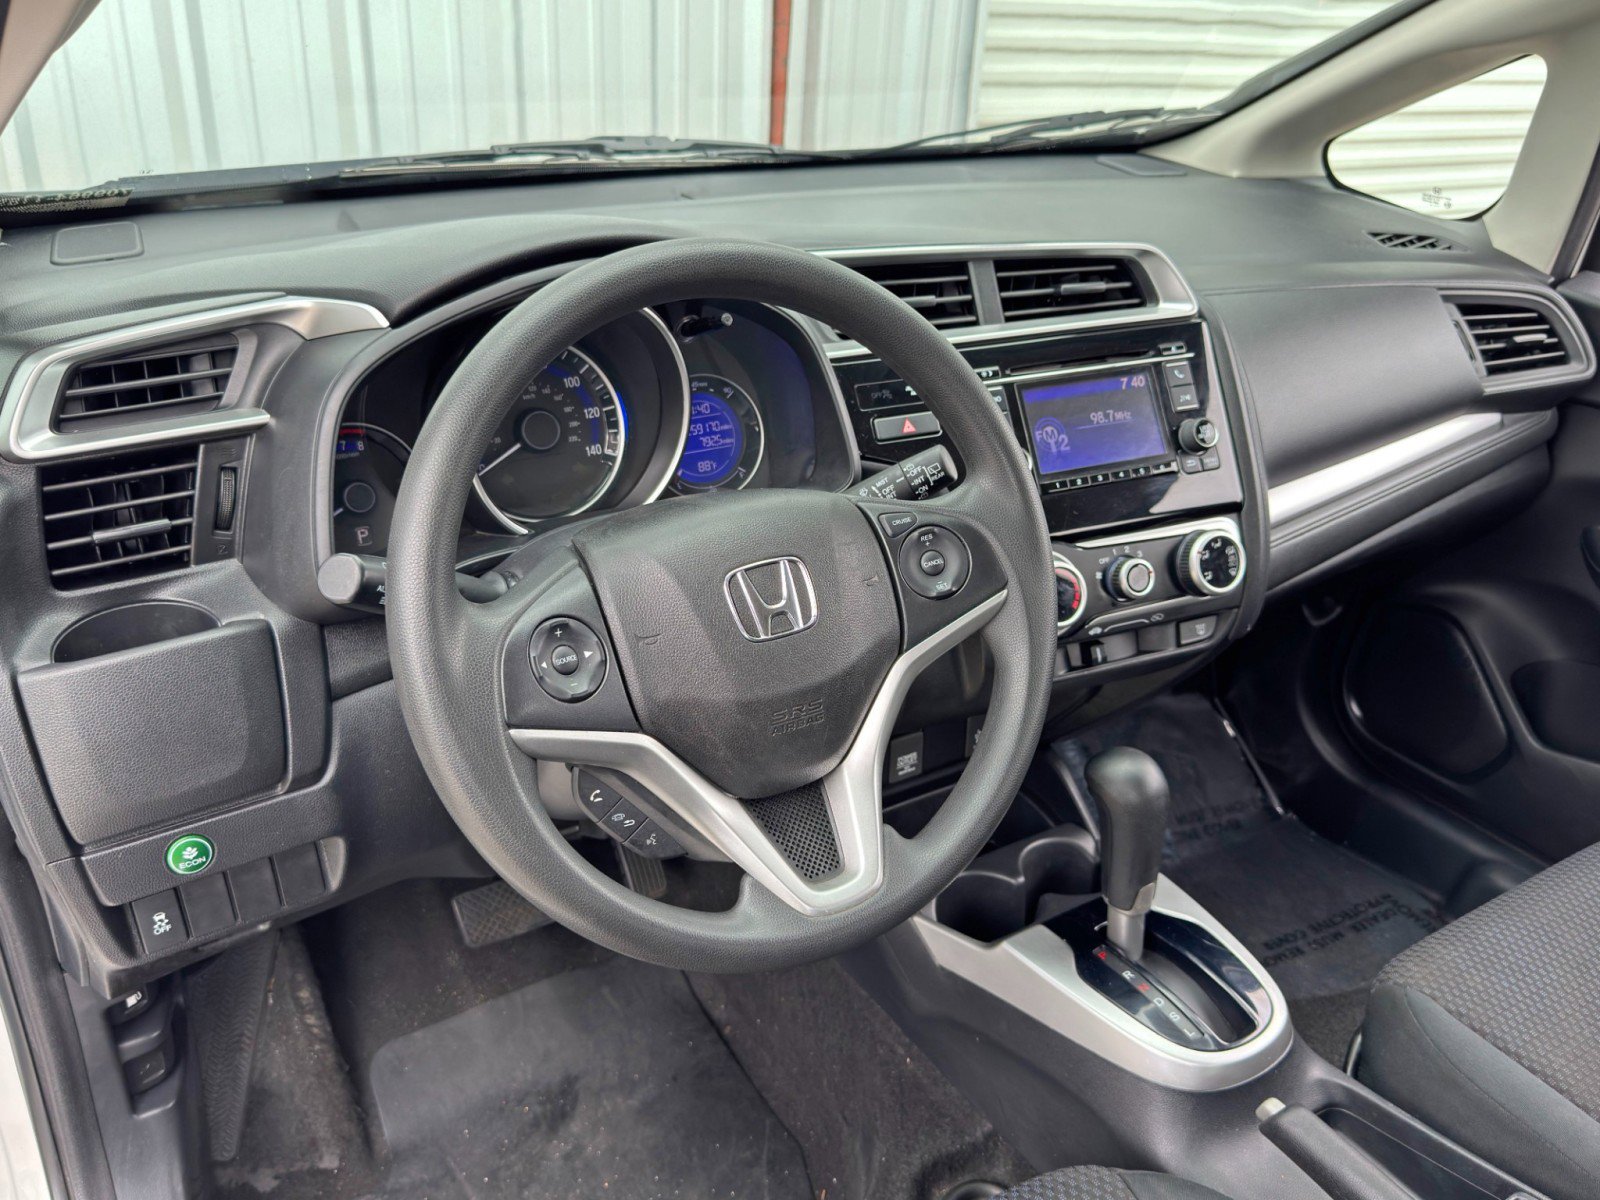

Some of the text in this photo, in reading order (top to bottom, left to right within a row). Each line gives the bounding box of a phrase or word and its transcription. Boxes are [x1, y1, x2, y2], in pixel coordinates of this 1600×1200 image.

[563, 376, 581, 389] 100
[584, 407, 601, 420] 120
[585, 444, 603, 457] 140
[909, 466, 922, 477] OFF
[881, 484, 895, 495] OFF
[918, 484, 929, 494] ON
[891, 516, 912, 526] CRUISE
[920, 533, 934, 542] RES
[923, 558, 945, 568] CANCEL
[555, 654, 578, 666] SOURCE
[771, 699, 824, 725] SRS
[178, 855, 207, 869] ECON
[153, 924, 172, 936] OFF
[1122, 970, 1135, 980] R
[1153, 997, 1164, 1007] D
[1169, 1011, 1181, 1021] S
[1183, 1028, 1195, 1038] L
